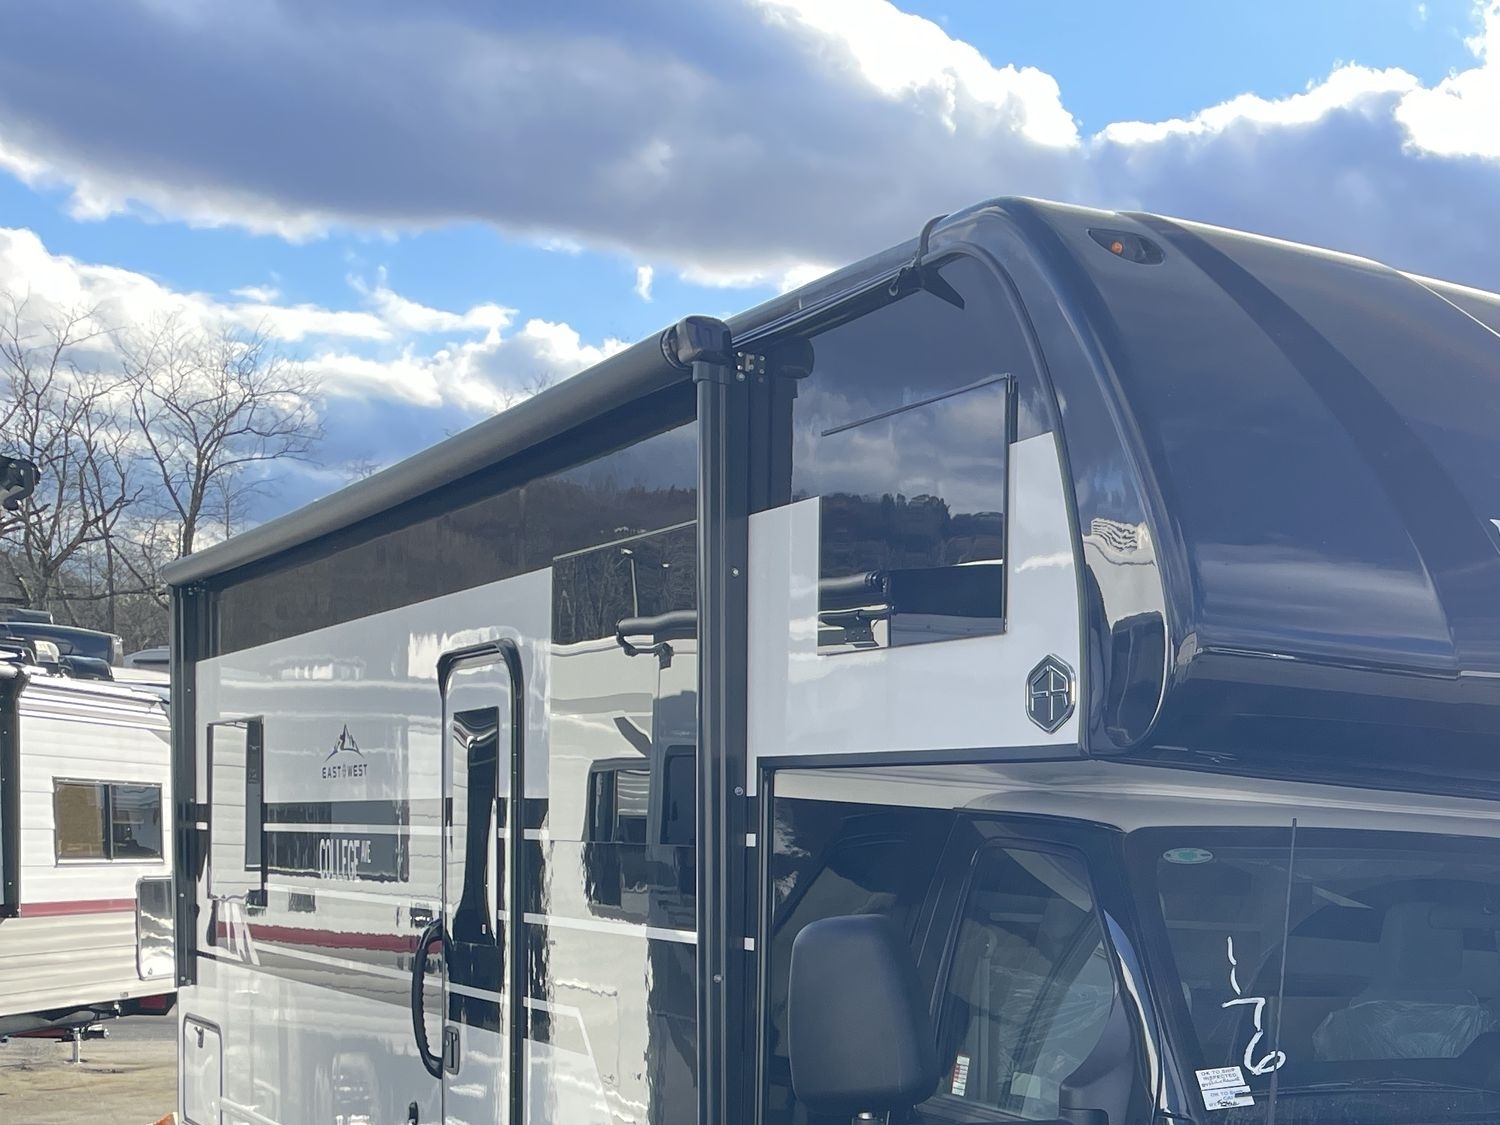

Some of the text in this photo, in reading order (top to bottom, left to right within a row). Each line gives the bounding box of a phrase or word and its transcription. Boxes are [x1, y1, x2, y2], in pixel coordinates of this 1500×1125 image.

[322, 766, 342, 779] EAST
[347, 763, 368, 777] WEST
[319, 838, 360, 883] COLLEGE
